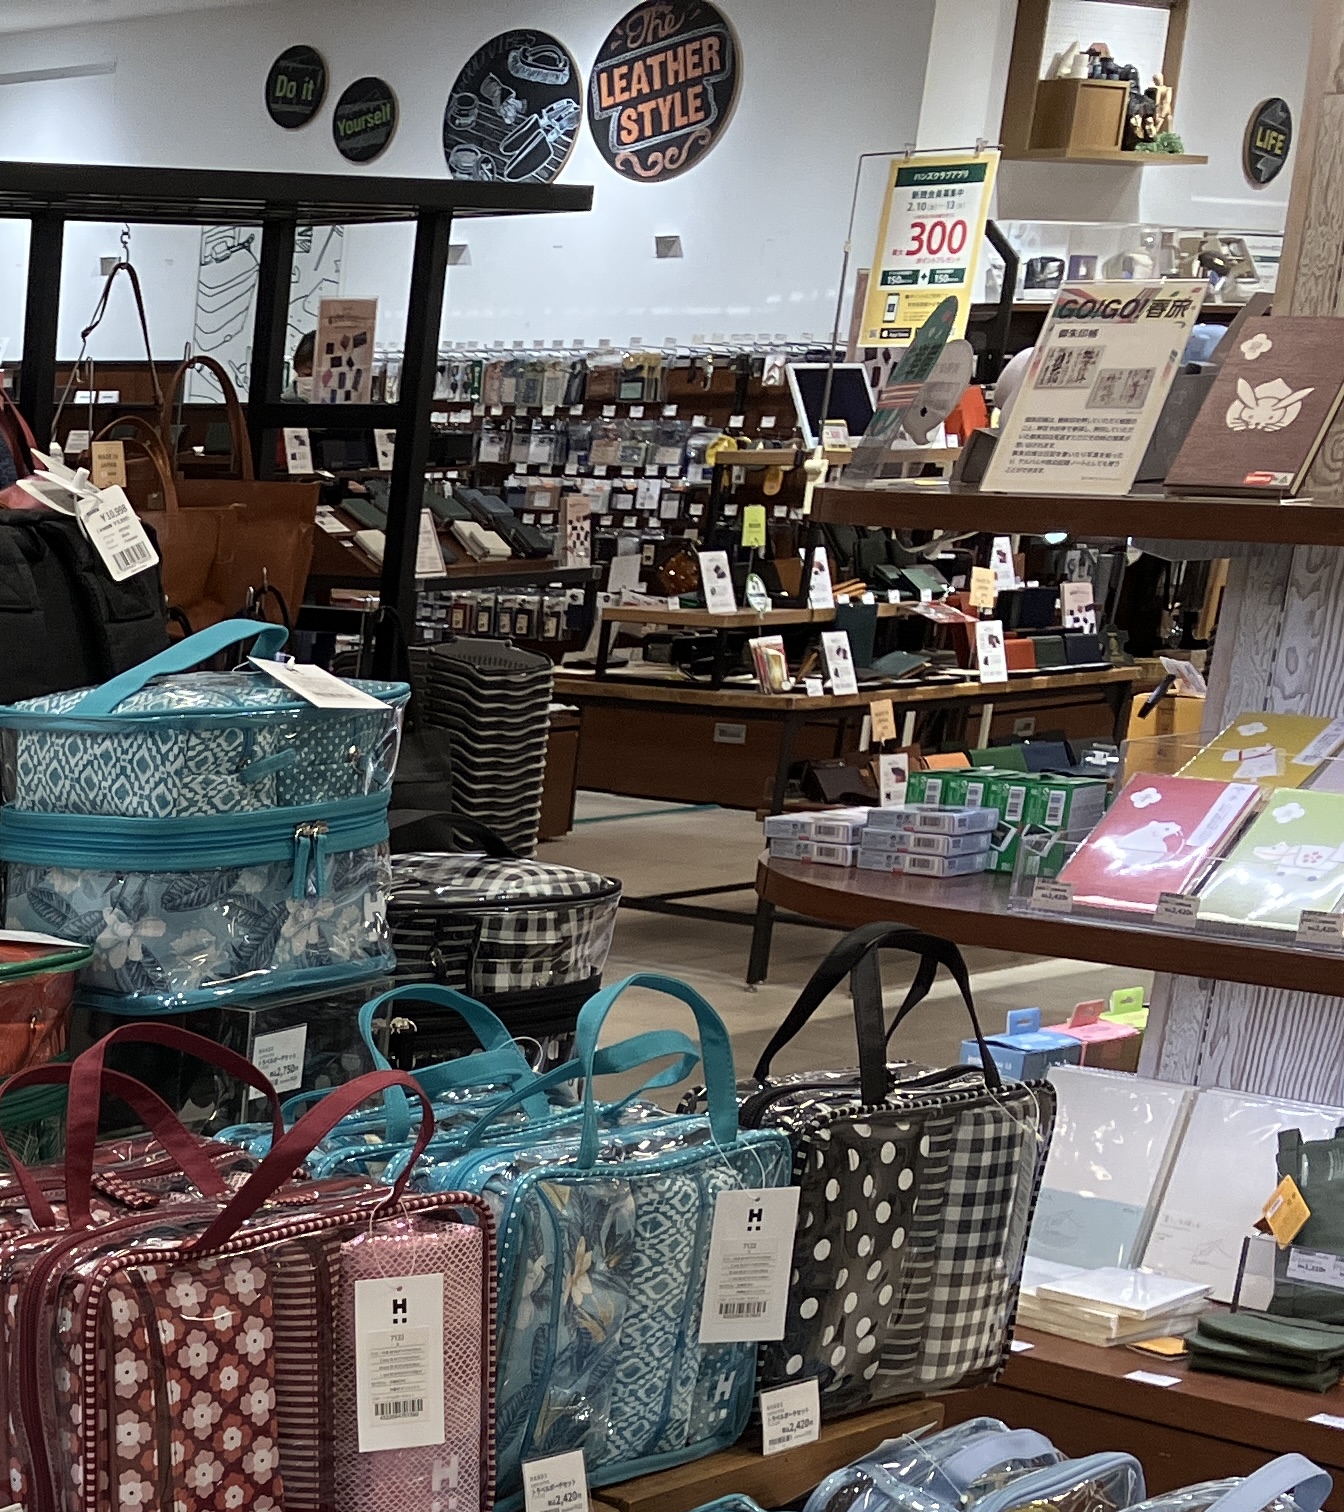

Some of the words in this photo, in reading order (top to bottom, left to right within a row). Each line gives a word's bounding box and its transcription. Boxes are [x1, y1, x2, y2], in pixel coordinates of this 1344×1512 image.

[626, 6, 682, 47] The
[275, 74, 298, 99] Do
[302, 73, 315, 100] it
[598, 36, 722, 108] LEATHER
[337, 103, 392, 138] Yourself
[620, 85, 706, 145] STYLE
[1255, 126, 1287, 155] LIFE
[392, 1297, 407, 1314] H
